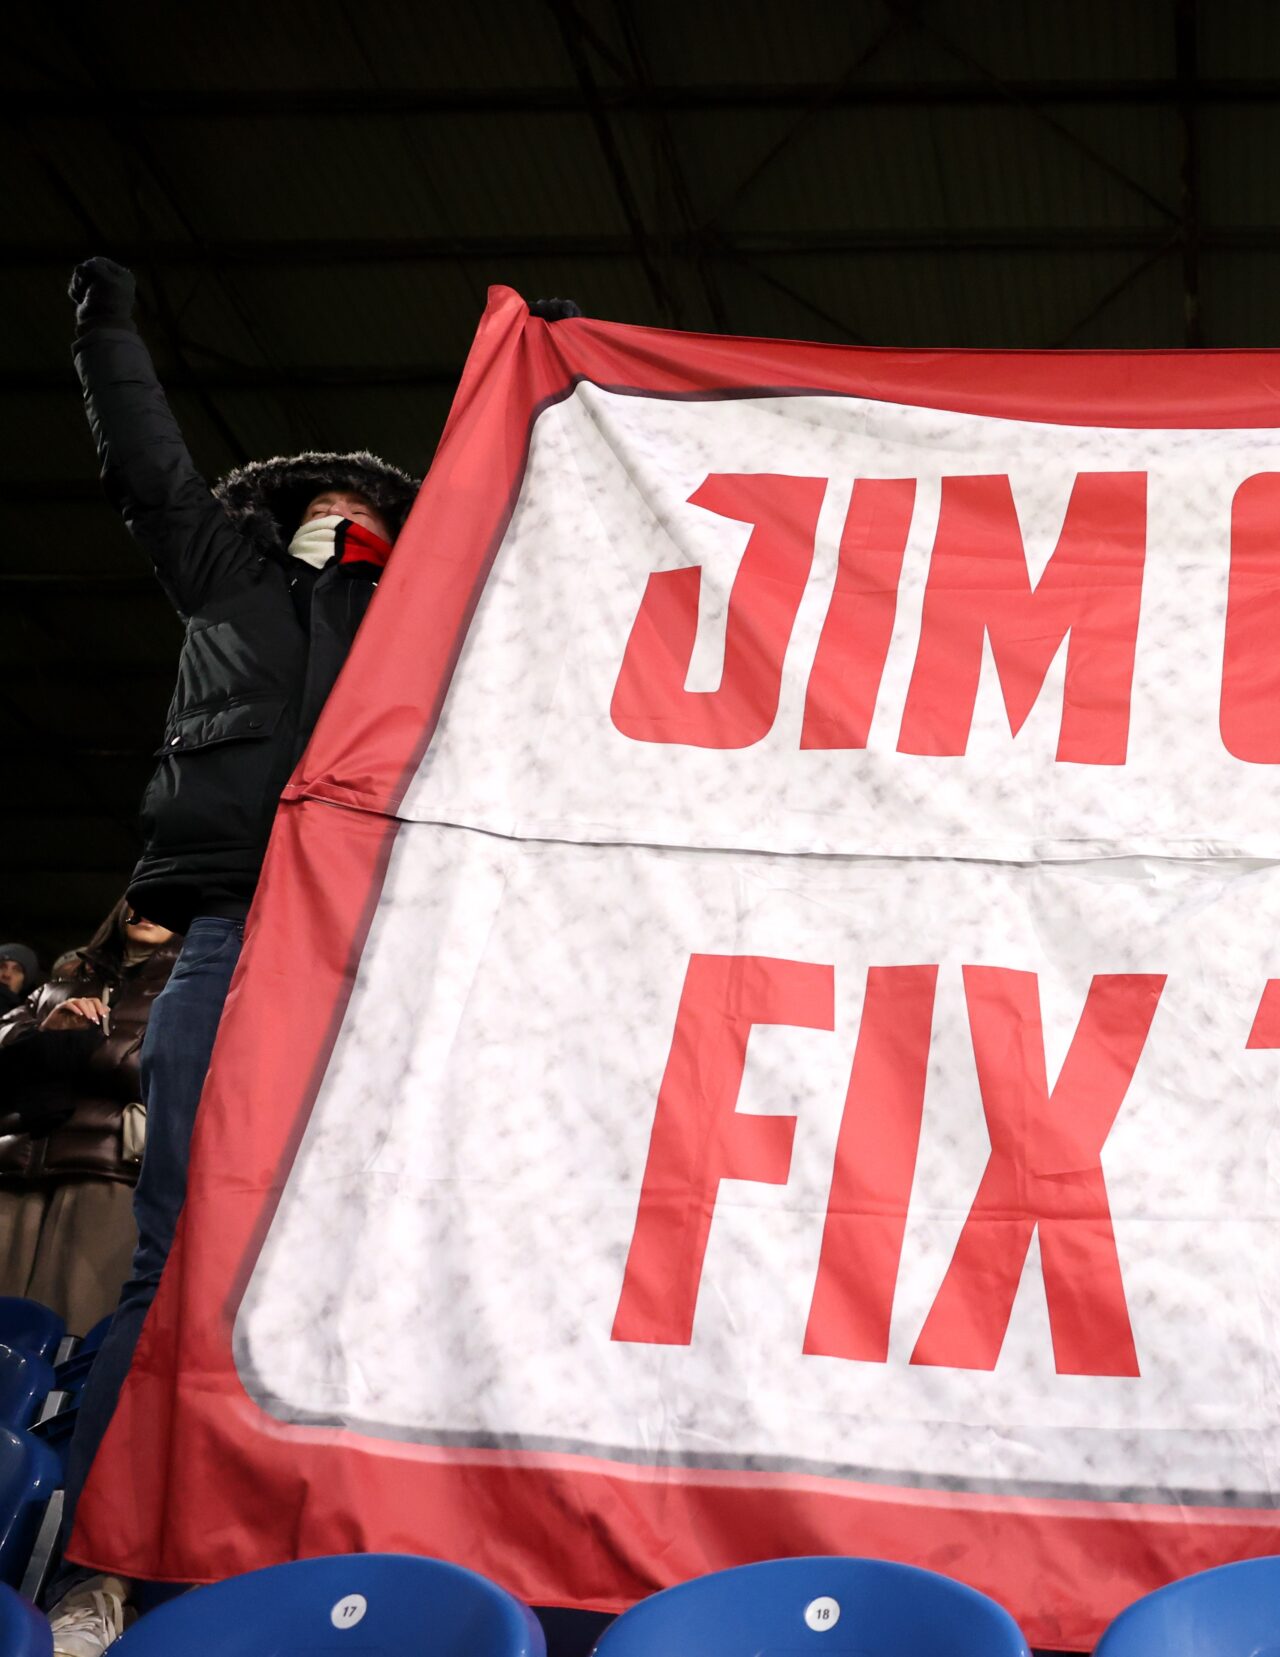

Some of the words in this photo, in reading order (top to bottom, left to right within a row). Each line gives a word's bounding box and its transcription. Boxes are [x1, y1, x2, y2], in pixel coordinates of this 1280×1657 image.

[611, 472, 1148, 766] JIM
[611, 953, 1167, 1378] FIX
[342, 1605, 358, 1618] 17
[816, 1608, 831, 1621] 18
